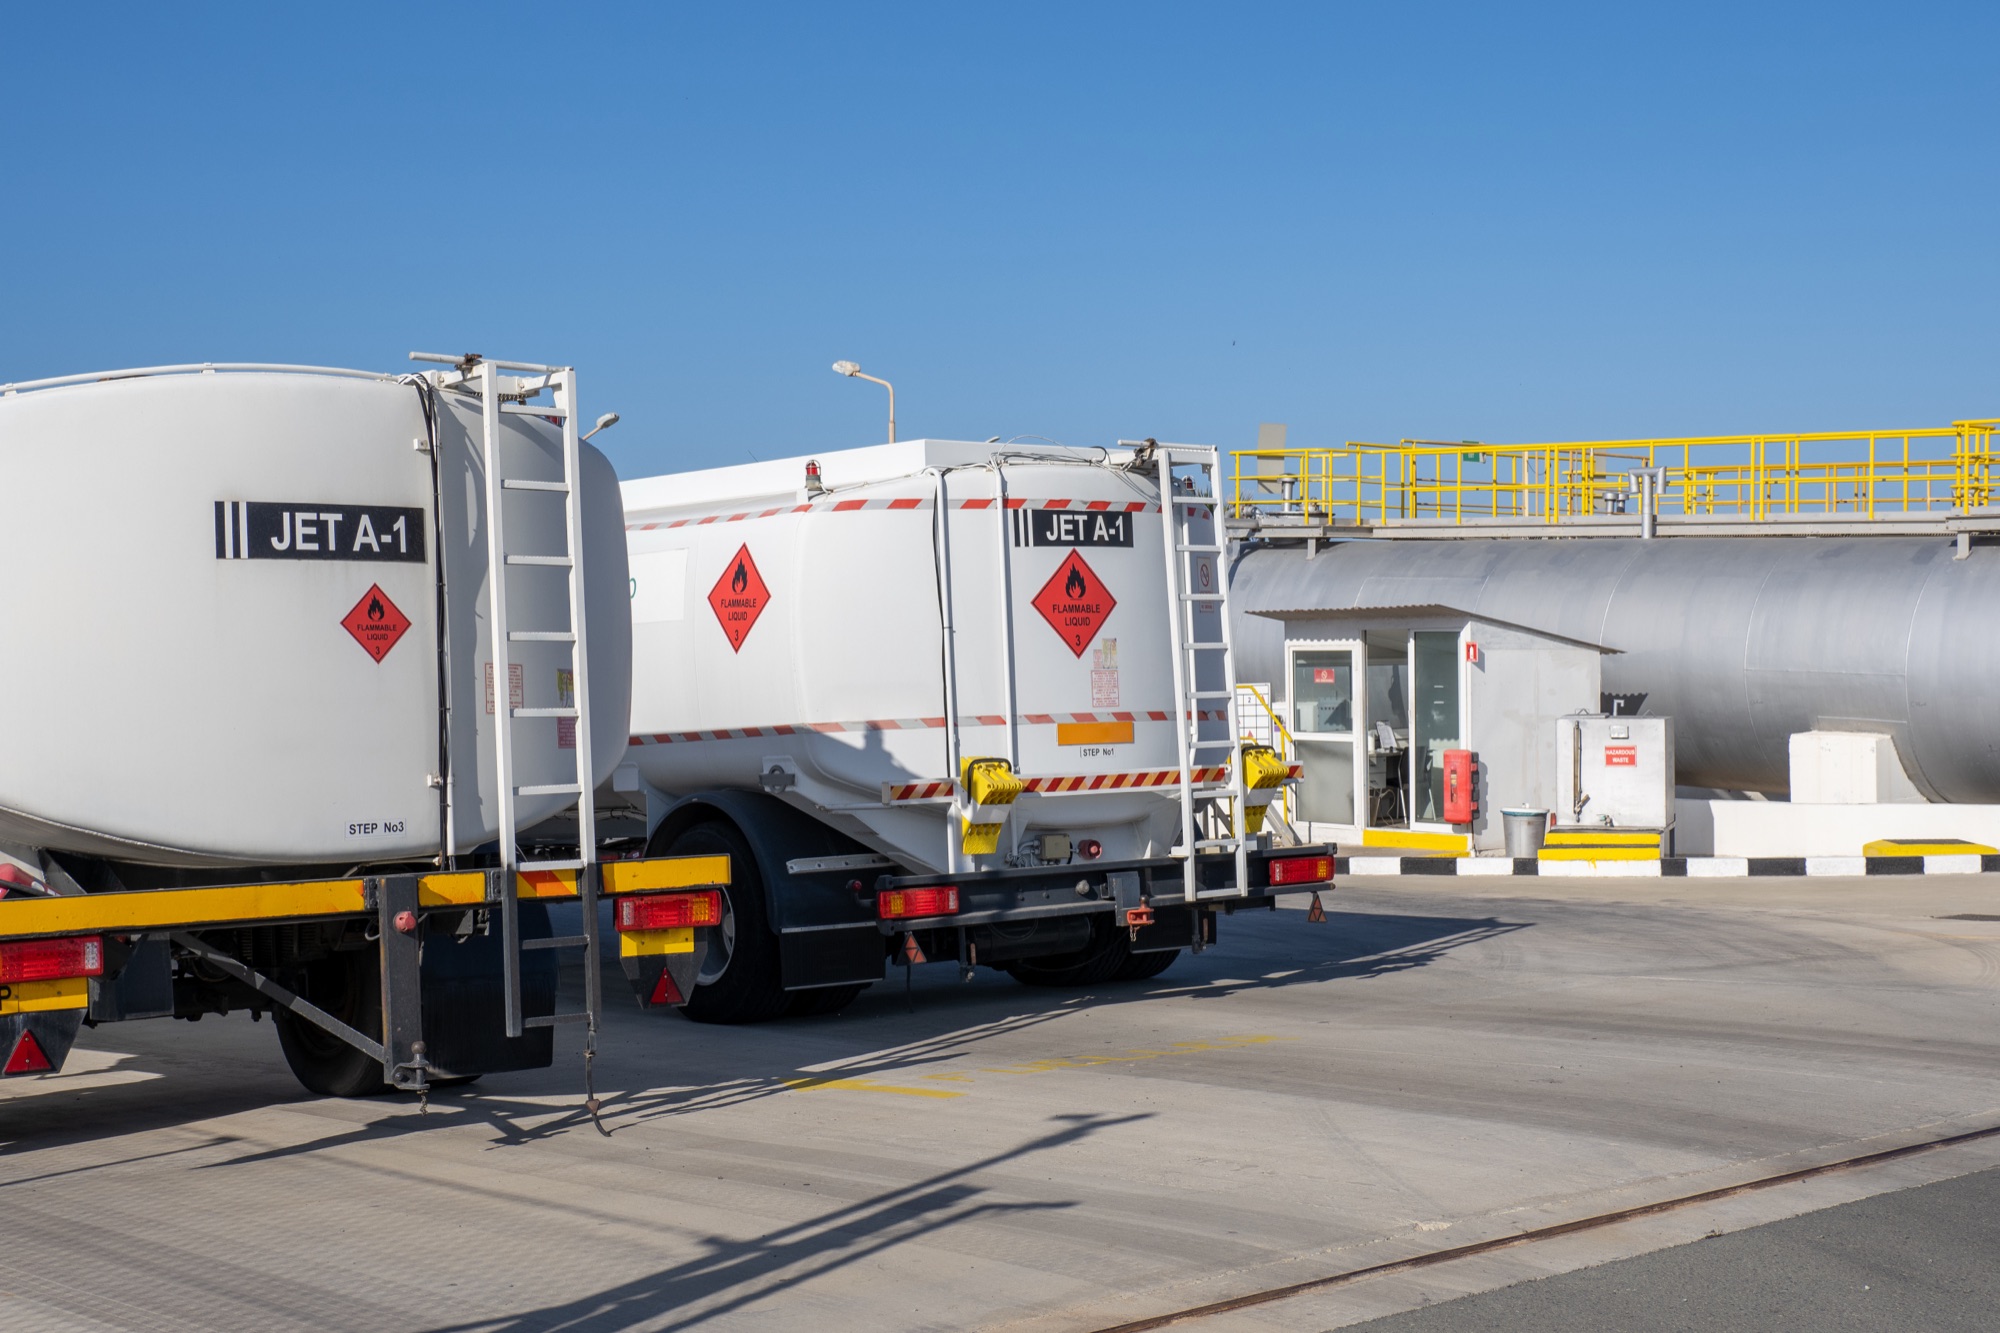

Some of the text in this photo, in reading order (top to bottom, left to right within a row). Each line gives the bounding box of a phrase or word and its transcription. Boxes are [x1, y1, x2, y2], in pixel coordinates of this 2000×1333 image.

[270, 511, 407, 553] JET A-1
[1046, 514, 1124, 542] JET A-1
[720, 598, 757, 609] FLAMMABLE
[1052, 604, 1101, 614] FLAMMABLE
[728, 611, 748, 621] LIQUID
[1064, 616, 1091, 626] LIQUID
[357, 624, 397, 632] FLAMMABLE
[366, 633, 389, 641] LIQUID
[734, 629, 739, 641] 3
[1075, 634, 1081, 647] 3
[375, 645, 381, 655] 3
[1083, 747, 1115, 757] STEP No1
[349, 821, 404, 835] STEP No3
